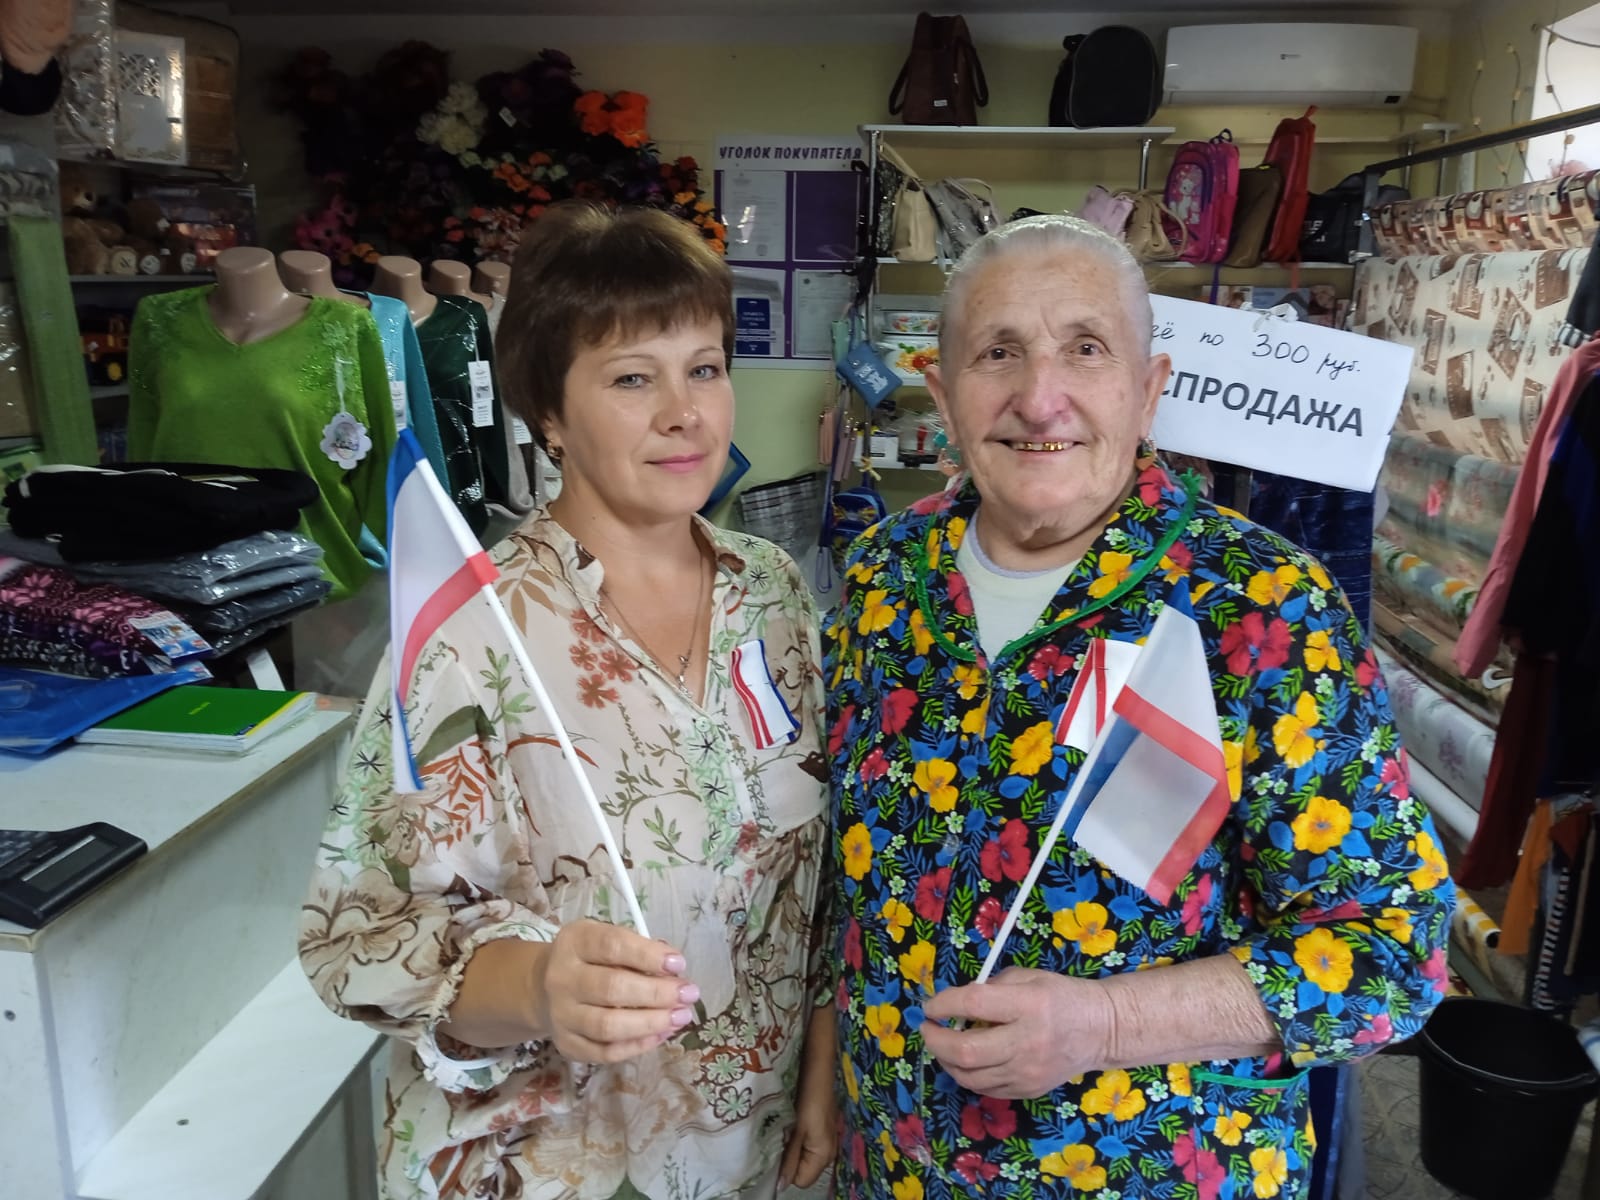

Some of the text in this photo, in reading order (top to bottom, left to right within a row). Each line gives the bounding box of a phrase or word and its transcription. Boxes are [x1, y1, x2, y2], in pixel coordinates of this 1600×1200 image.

[719, 146, 862, 160] УГОЛОК ПОКУПАТЕЛЯ
[1200, 331, 1224, 347] по
[1252, 333, 1310, 364] 300
